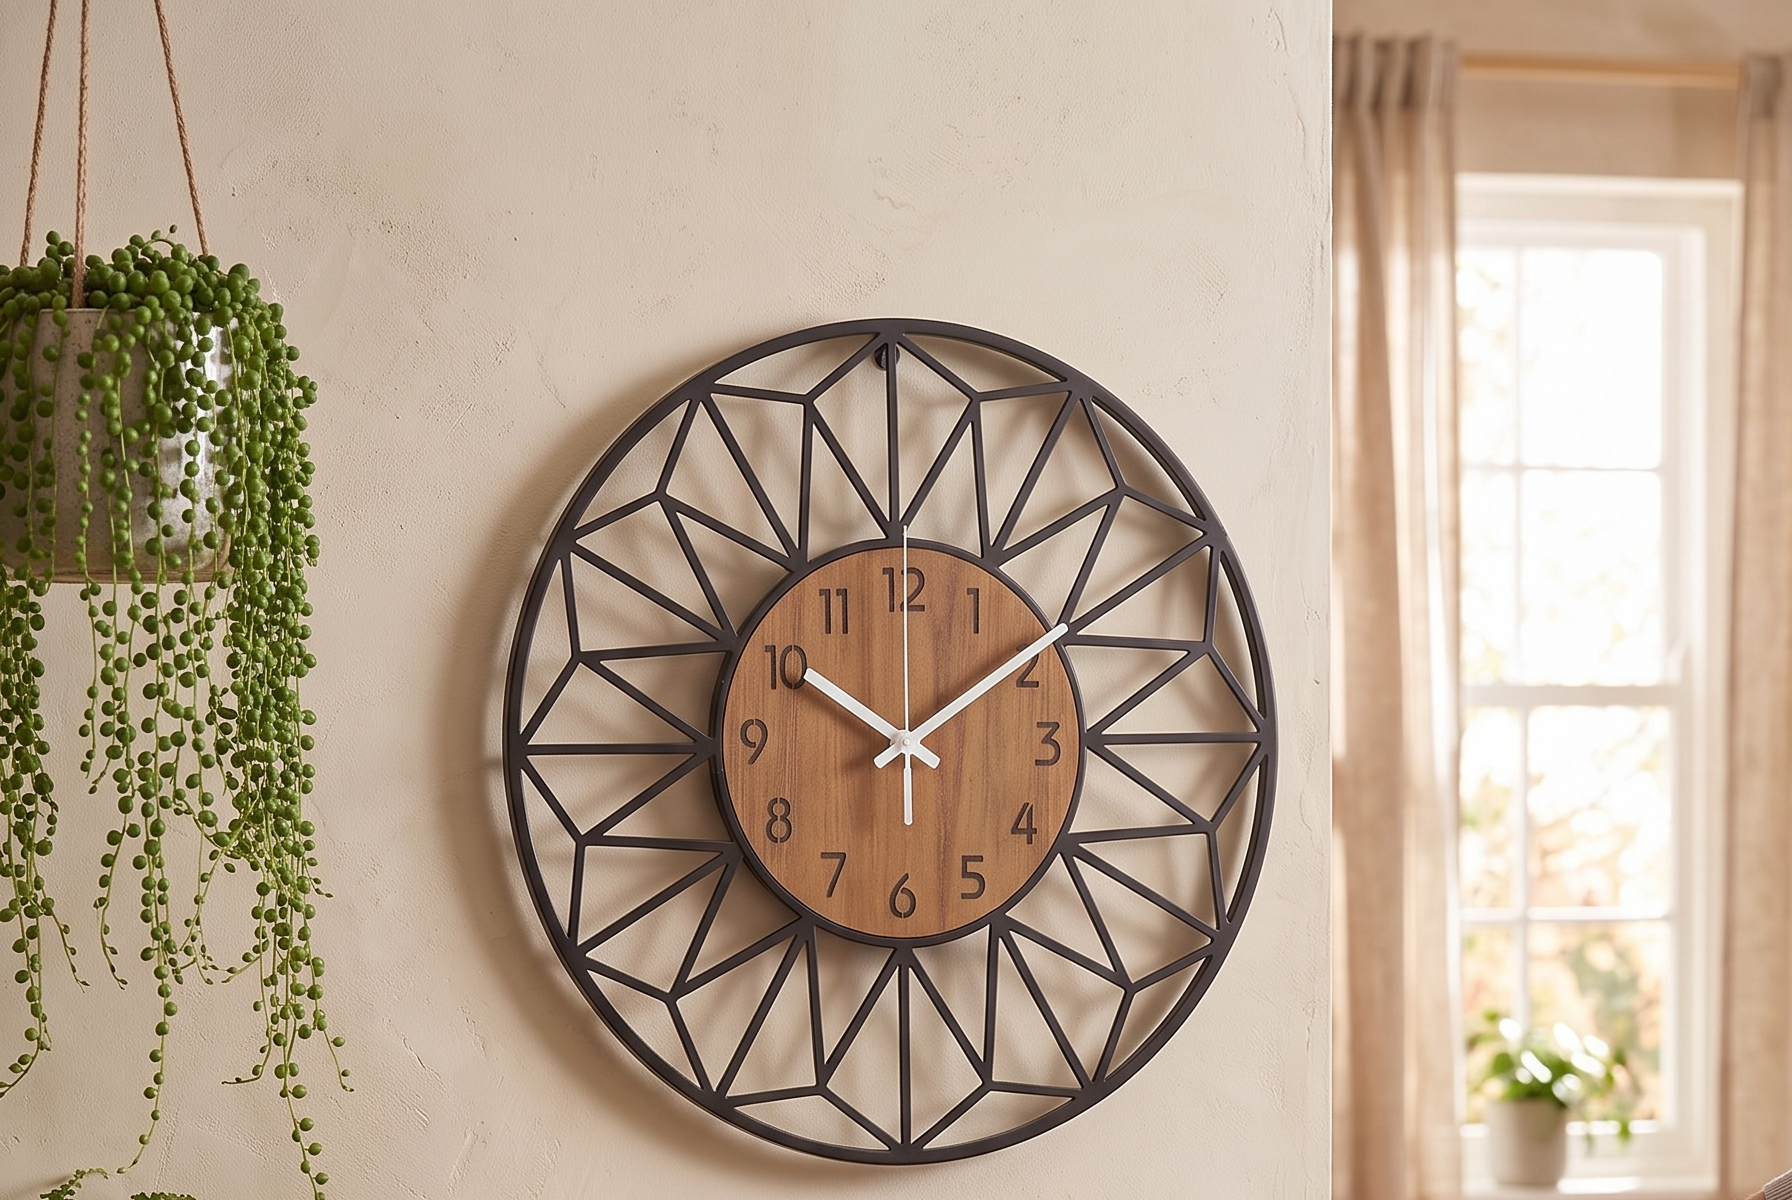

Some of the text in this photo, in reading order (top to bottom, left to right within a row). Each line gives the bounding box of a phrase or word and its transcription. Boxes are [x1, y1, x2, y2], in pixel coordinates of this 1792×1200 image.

[819, 588, 848, 634] 11
[883, 567, 925, 612] 12
[967, 588, 980, 634] 1
[765, 644, 807, 690] 10
[1016, 644, 1039, 688] 2
[740, 719, 768, 765] 9
[1035, 722, 1061, 766] 3
[766, 797, 792, 843] 8
[1011, 802, 1037, 844] 4
[820, 852, 847, 898] 7
[889, 872, 916, 919] 6
[960, 855, 986, 899] 5
